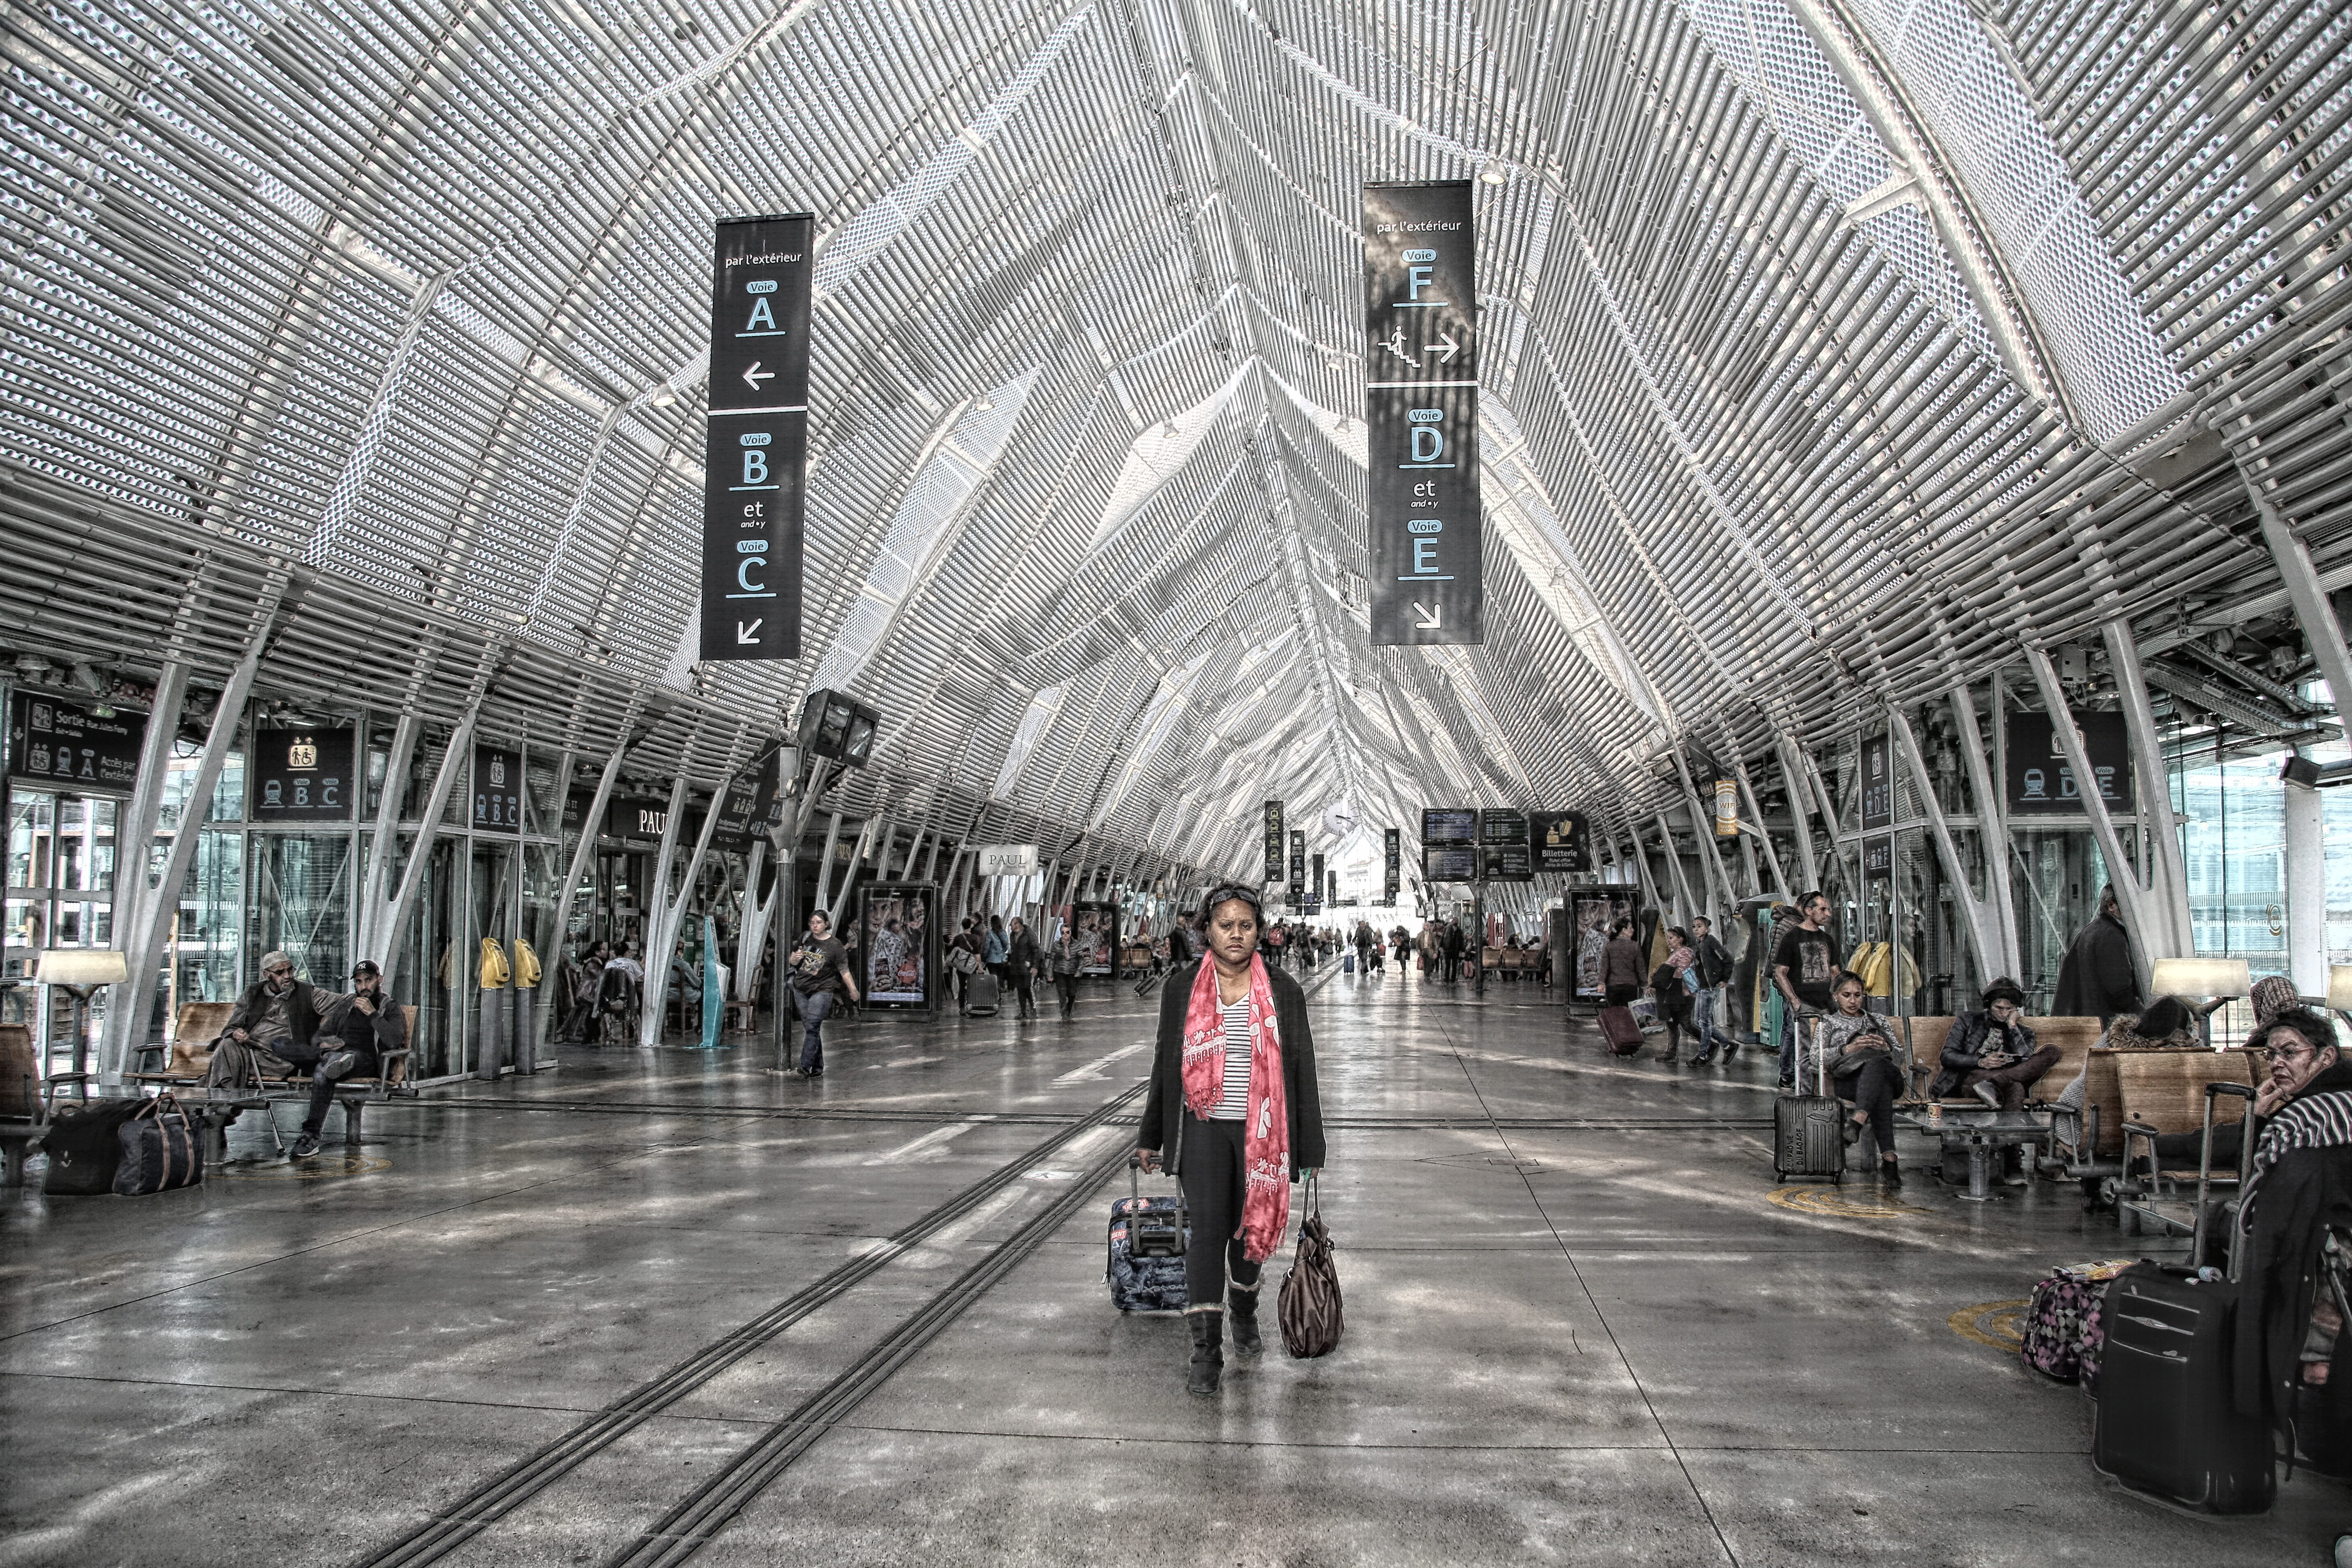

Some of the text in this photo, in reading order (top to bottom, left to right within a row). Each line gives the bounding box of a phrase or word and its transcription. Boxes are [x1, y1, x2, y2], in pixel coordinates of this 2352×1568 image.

[1377, 220, 1461, 235] par l'extérieur
[725, 252, 802, 269] par l'extérieur
[1407, 250, 1432, 261] Voie
[751, 282, 774, 292] Voie
[1409, 266, 1433, 301] F
[746, 297, 777, 331] A
[1412, 411, 1439, 420] Voie
[745, 435, 767, 445] Voie
[1411, 426, 1444, 462] D
[743, 450, 768, 484] B
[1414, 480, 1436, 497] et
[744, 501, 764, 517] et
[1412, 521, 1437, 531] Voie
[741, 541, 764, 551] Voie
[1414, 537, 1439, 574] E
[738, 556, 767, 592] C
[56, 711, 85, 727] Sortie
[82, 758, 94, 776] A
[2061, 776, 2114, 797] D E
[296, 786, 338, 805] B C
[493, 803, 516, 823] B C
[639, 809, 669, 834] PAU
[989, 854, 1027, 865] PAUL
[1797, 1156, 1804, 1165] DU
